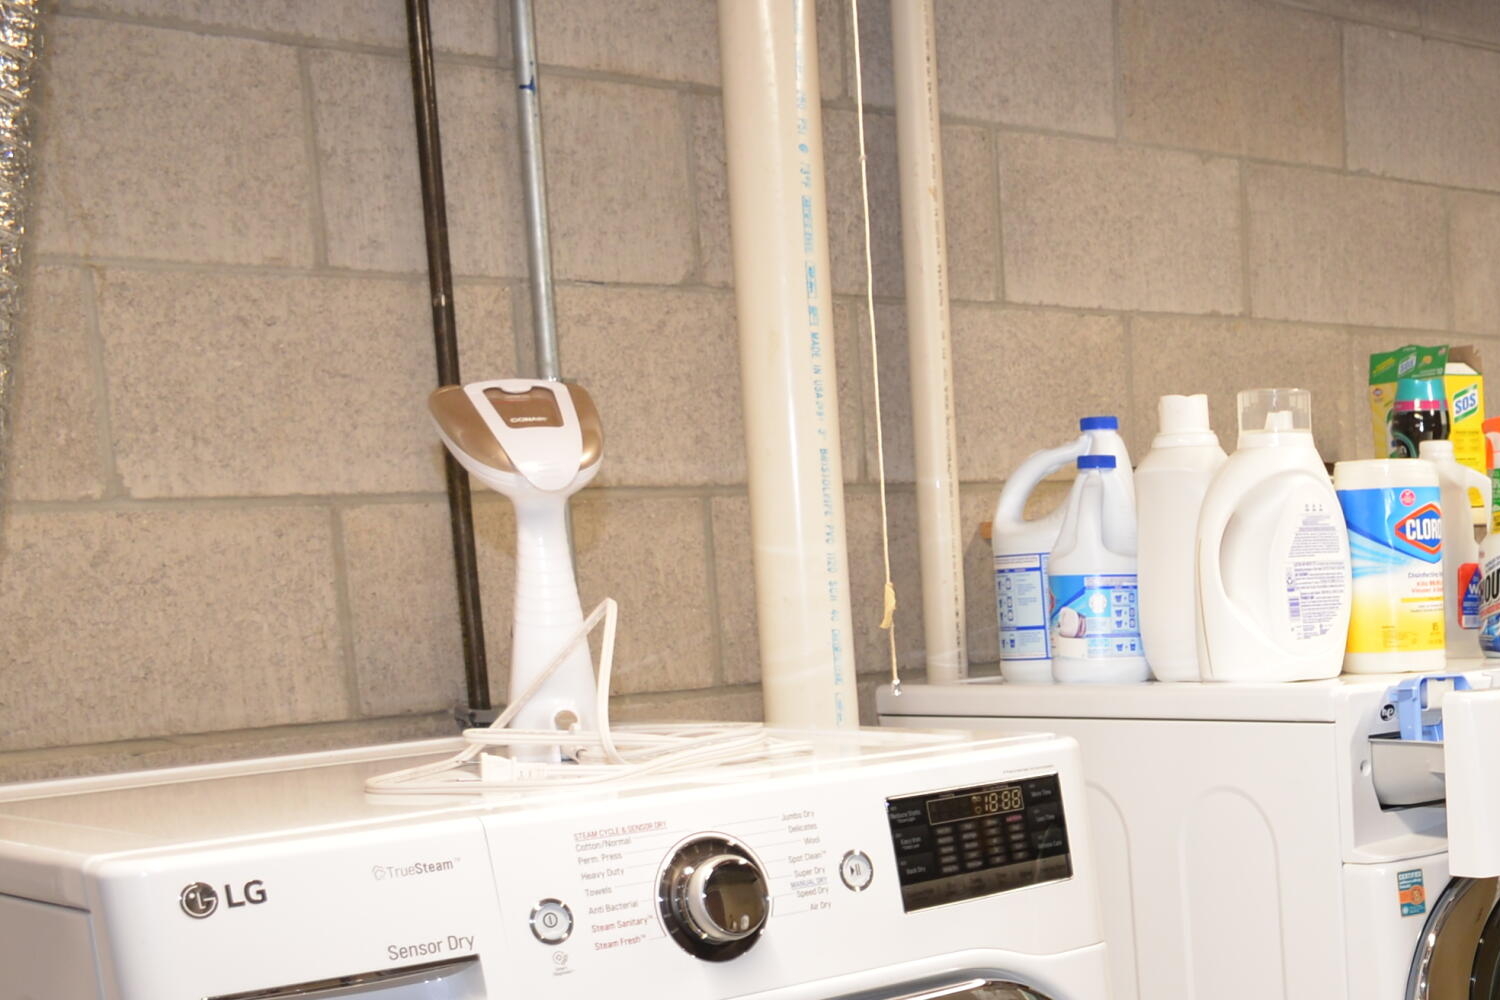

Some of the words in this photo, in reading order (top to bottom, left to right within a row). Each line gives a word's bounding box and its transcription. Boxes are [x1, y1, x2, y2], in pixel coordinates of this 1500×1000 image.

[810, 332, 822, 359] MADE
[574, 829, 598, 841] STEAM
[575, 837, 632, 851] Cotton/Normal
[601, 852, 622, 862] Press
[581, 870, 605, 881] Heavy
[607, 866, 624, 877] Duty
[224, 879, 268, 908] LG
[585, 886, 612, 897] Towels
[605, 900, 638, 912] Bacterial
[591, 922, 616, 933] Steam
[387, 941, 442, 961] Sensor
[447, 935, 474, 951] Dry
[594, 939, 618, 951] Steam
